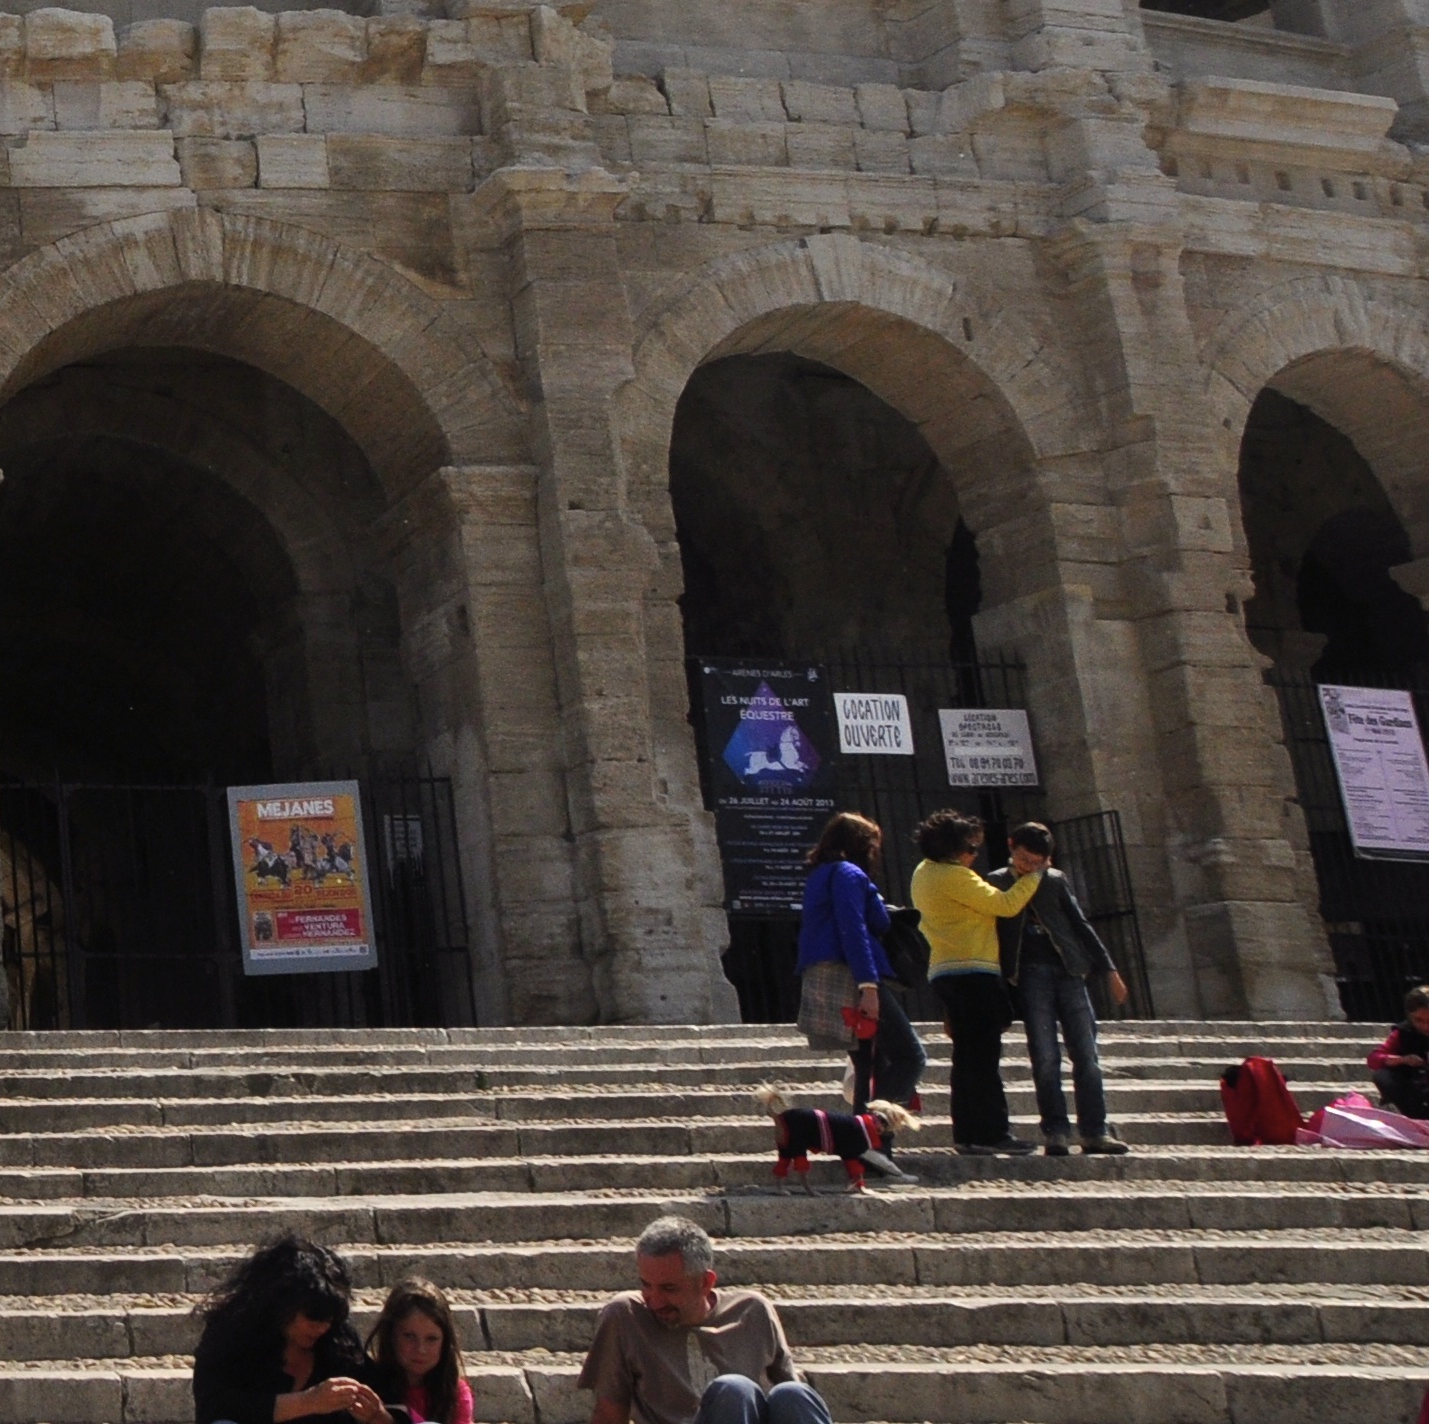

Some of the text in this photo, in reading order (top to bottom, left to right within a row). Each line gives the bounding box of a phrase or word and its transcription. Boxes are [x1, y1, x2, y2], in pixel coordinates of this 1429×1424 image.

[762, 669, 793, 678] D'ARLES
[721, 695, 809, 707] LES NUITS DE L'ART
[739, 708, 795, 721] ÉQUESTRE
[843, 699, 900, 721] LOCATION
[844, 725, 901, 748] OUVERTE
[1013, 757, 1024, 769] 70
[256, 799, 334, 817] MEJANES
[729, 797, 738, 805] 26
[740, 797, 769, 805] JUILLET
[780, 798, 790, 806] 24
[815, 798, 835, 807] 2013
[295, 914, 347, 923] FERNANDES
[302, 928, 356, 936] HERNANDEZ
[303, 922, 345, 930] VENTURA
